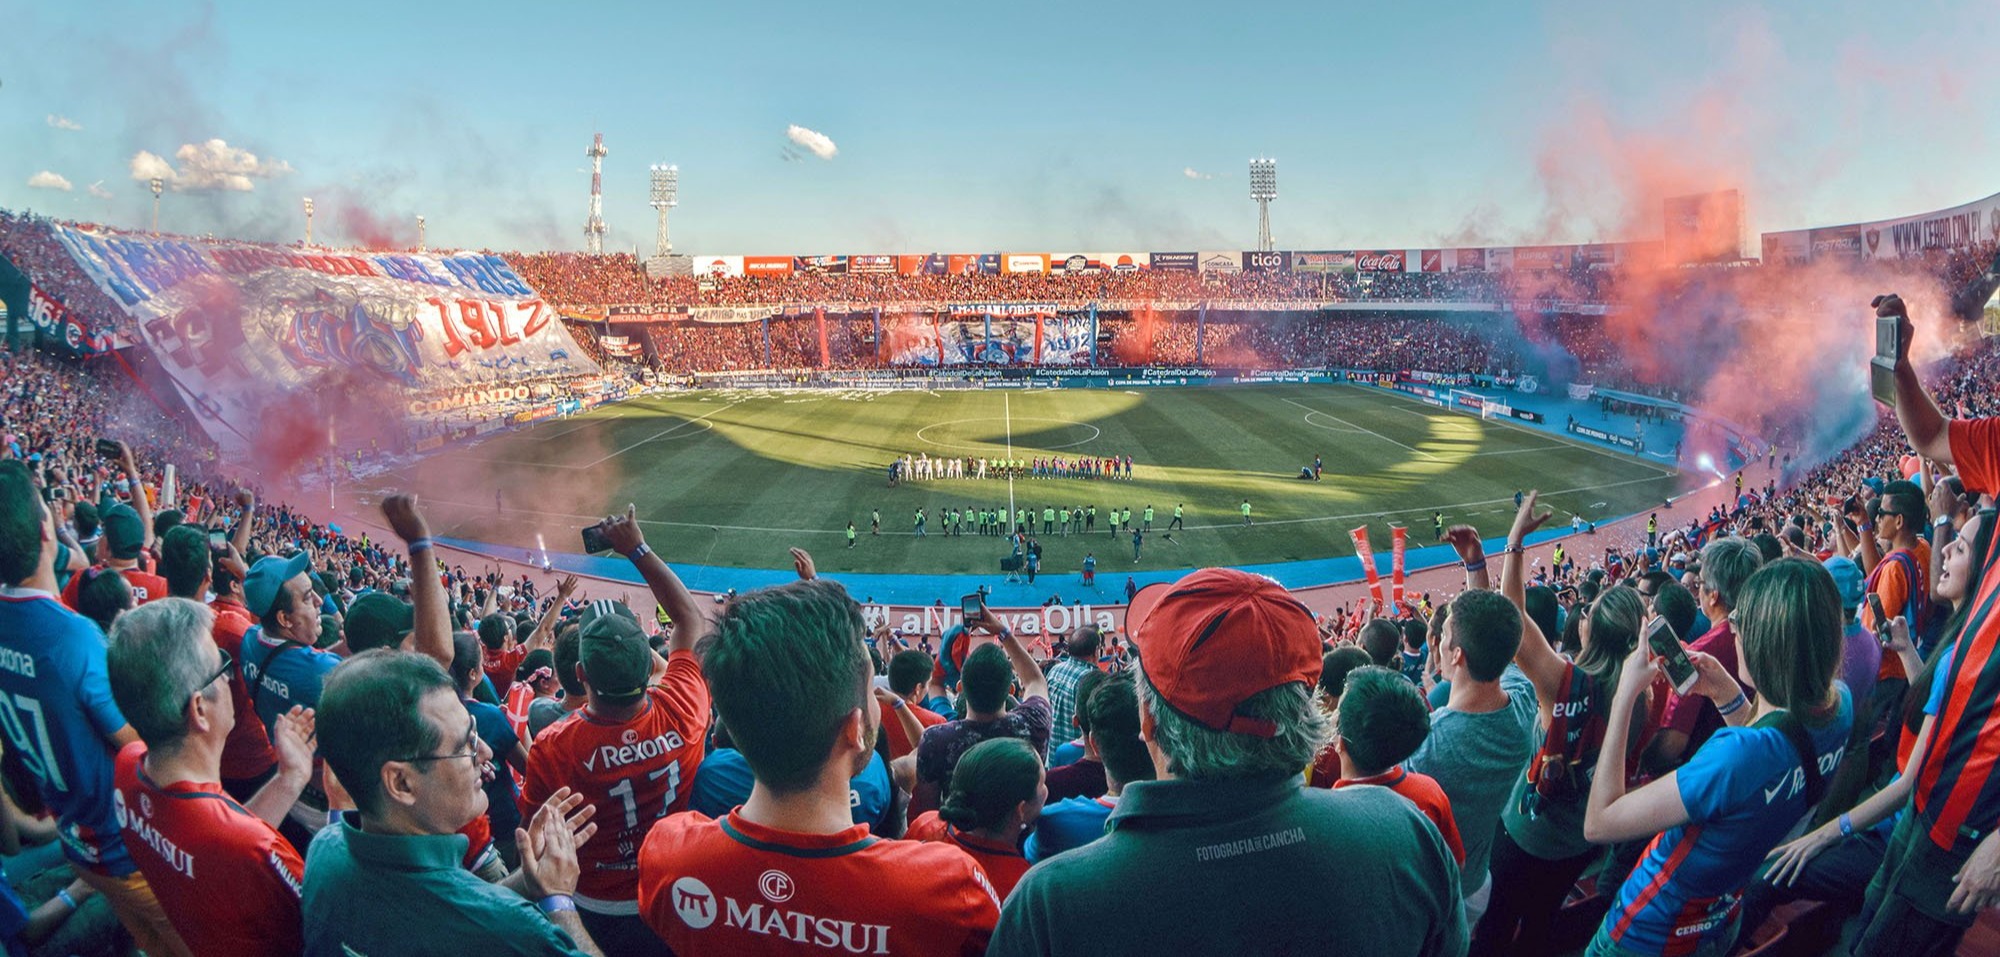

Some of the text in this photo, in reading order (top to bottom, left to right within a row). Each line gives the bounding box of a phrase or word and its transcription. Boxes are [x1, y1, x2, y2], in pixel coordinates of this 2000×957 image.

[425, 296, 551, 358] 1912
[1036, 368, 1109, 377] #CatedralDeLaPasión
[409, 385, 531, 415] COMANDO
[601, 730, 684, 769] Rexona
[609, 759, 681, 829] 17
[129, 808, 196, 879] MATSUI
[724, 896, 891, 955] MATSUI
[1675, 921, 1713, 937] CERRO
